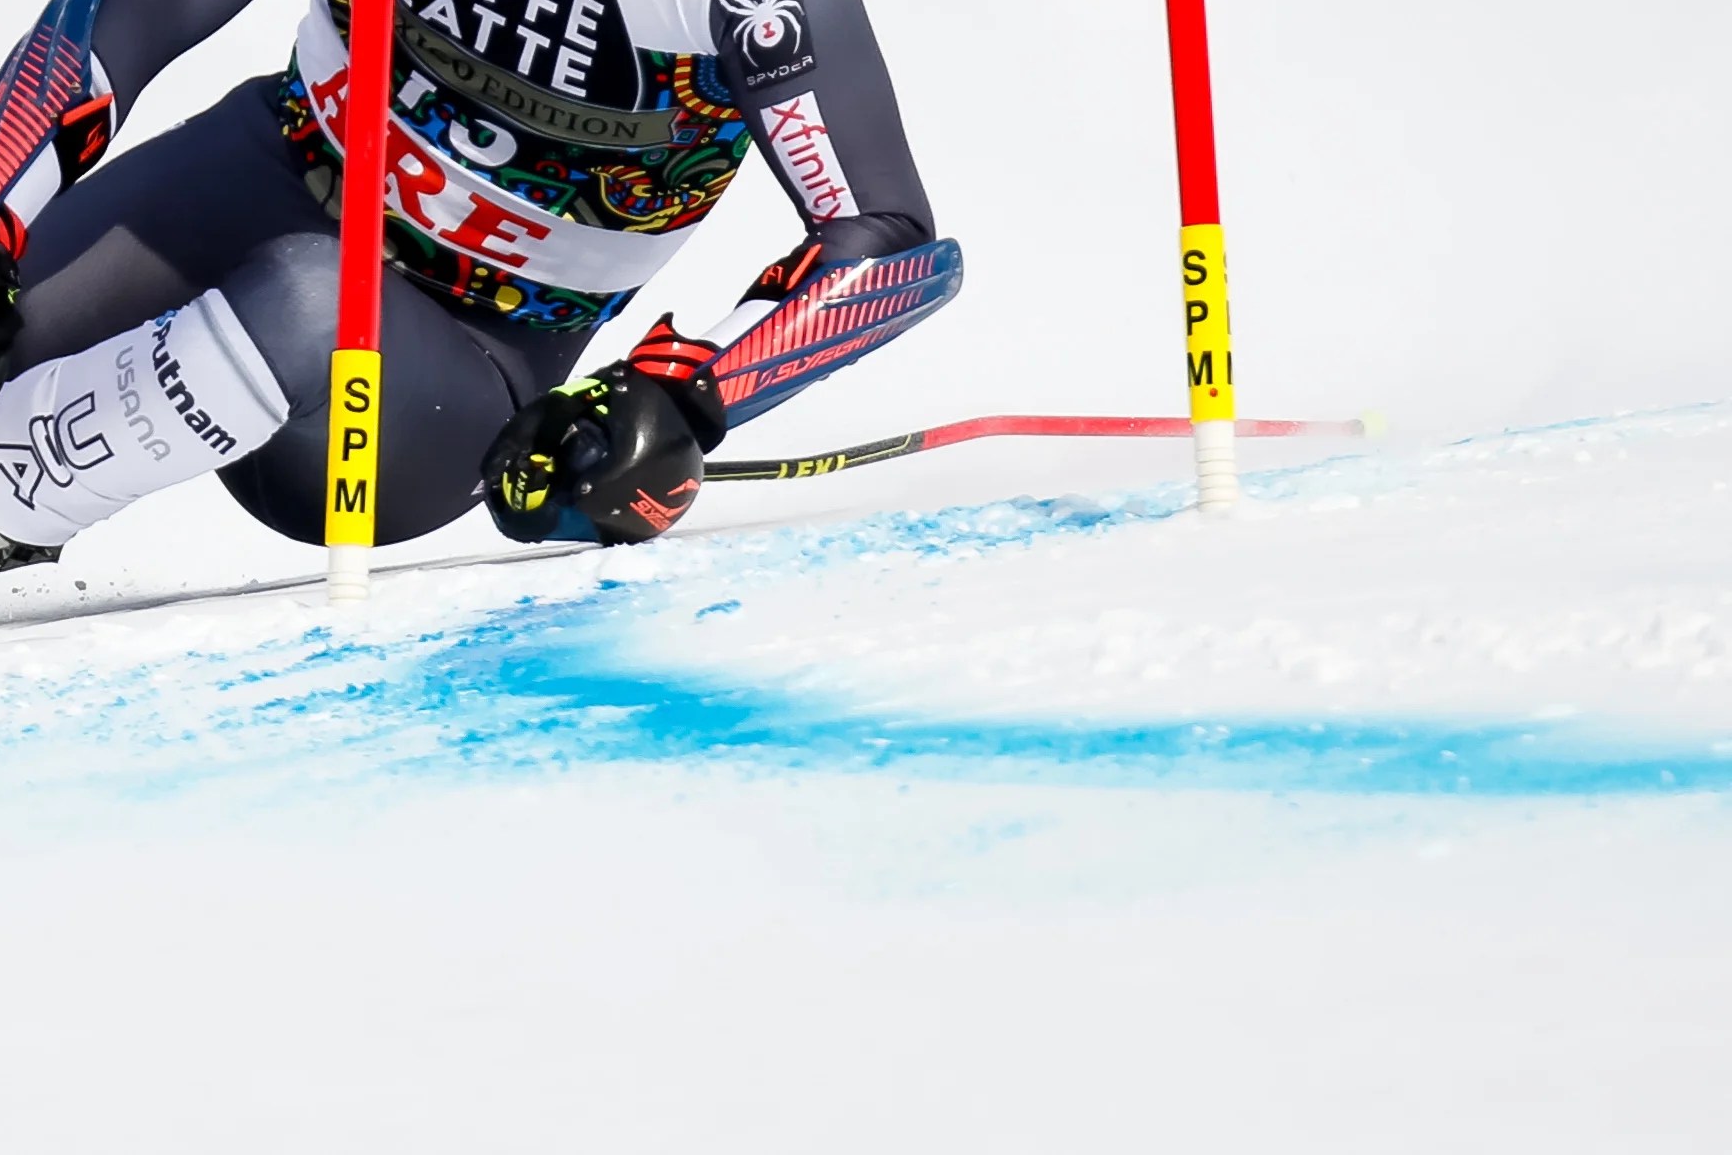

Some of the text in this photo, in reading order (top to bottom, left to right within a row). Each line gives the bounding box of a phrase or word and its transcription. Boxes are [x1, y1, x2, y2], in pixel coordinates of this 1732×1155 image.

[480, 72, 643, 141] EDITION
[745, 55, 815, 87] SPYDER
[768, 98, 842, 225] xfinity
[1182, 249, 1214, 388] SPM
[115, 345, 172, 463] USANA
[150, 321, 238, 456] Putnam
[334, 377, 370, 514] SPM
